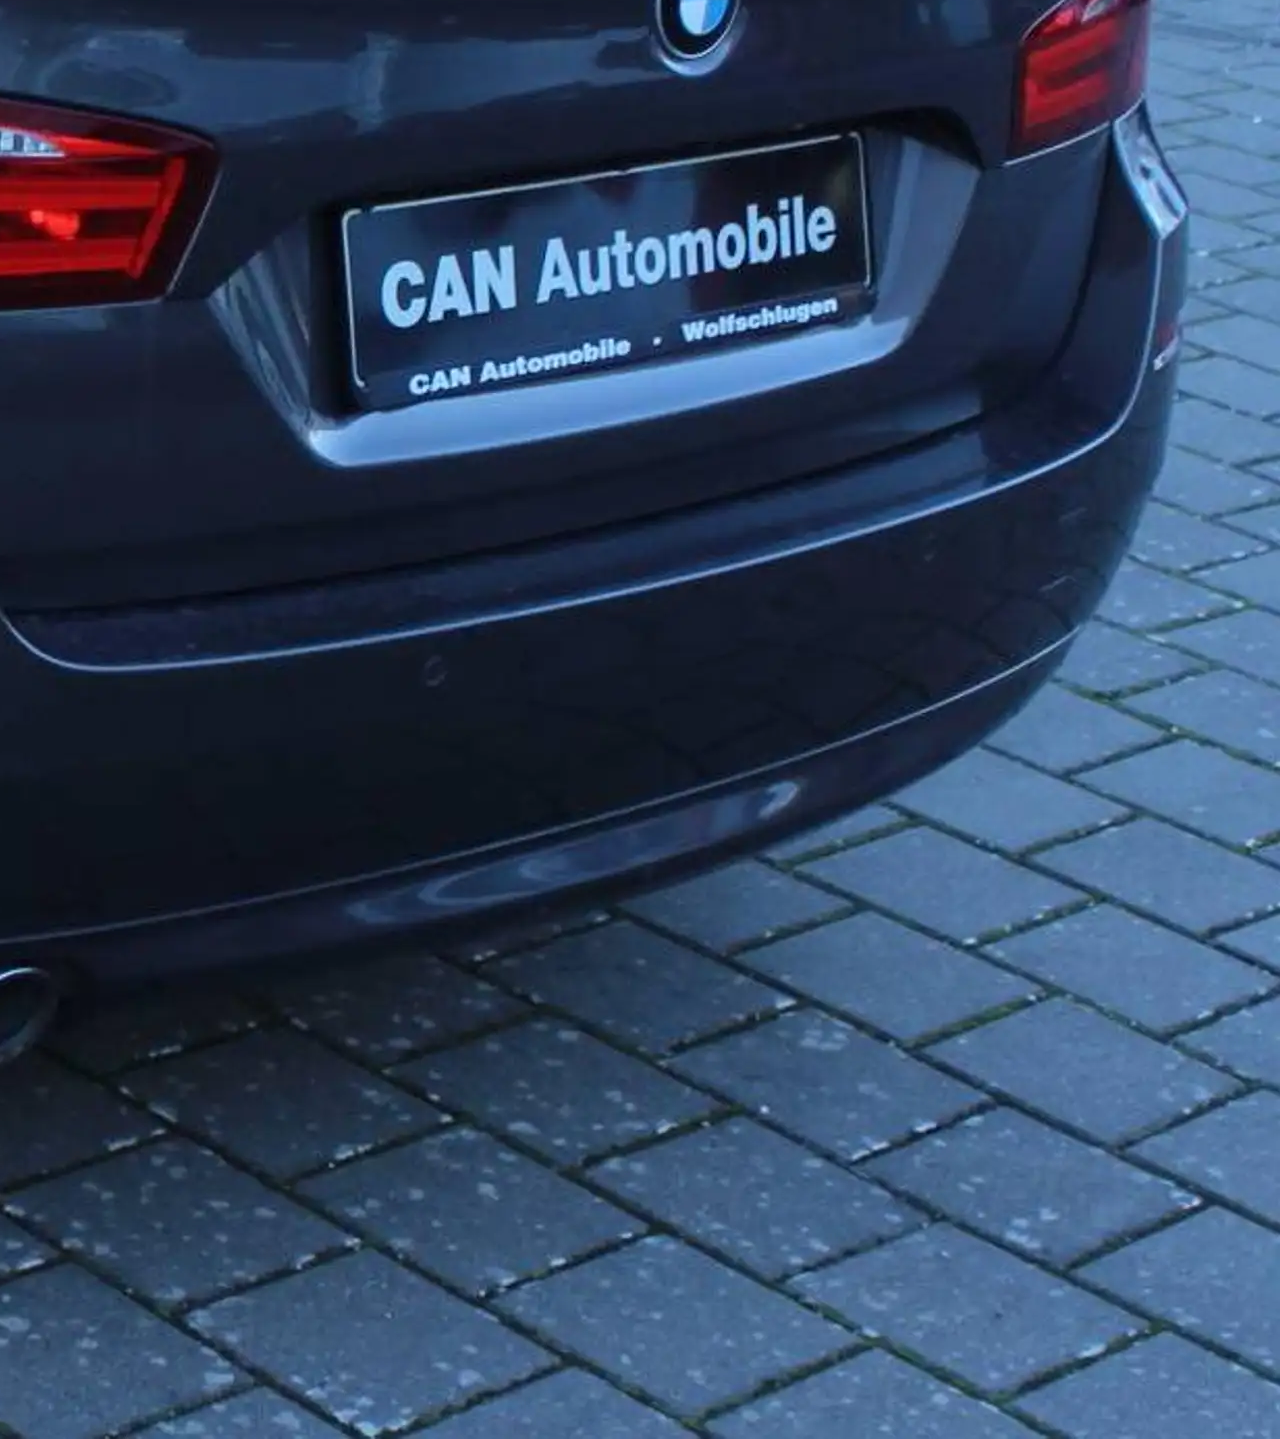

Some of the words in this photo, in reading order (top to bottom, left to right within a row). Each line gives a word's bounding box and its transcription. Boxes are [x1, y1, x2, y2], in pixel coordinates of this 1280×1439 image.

[381, 245, 517, 328] CAN
[536, 195, 837, 304] Automobile
[408, 366, 470, 395] CAN
[481, 337, 631, 383] Automobile
[682, 297, 838, 343] Wolfschlugen
